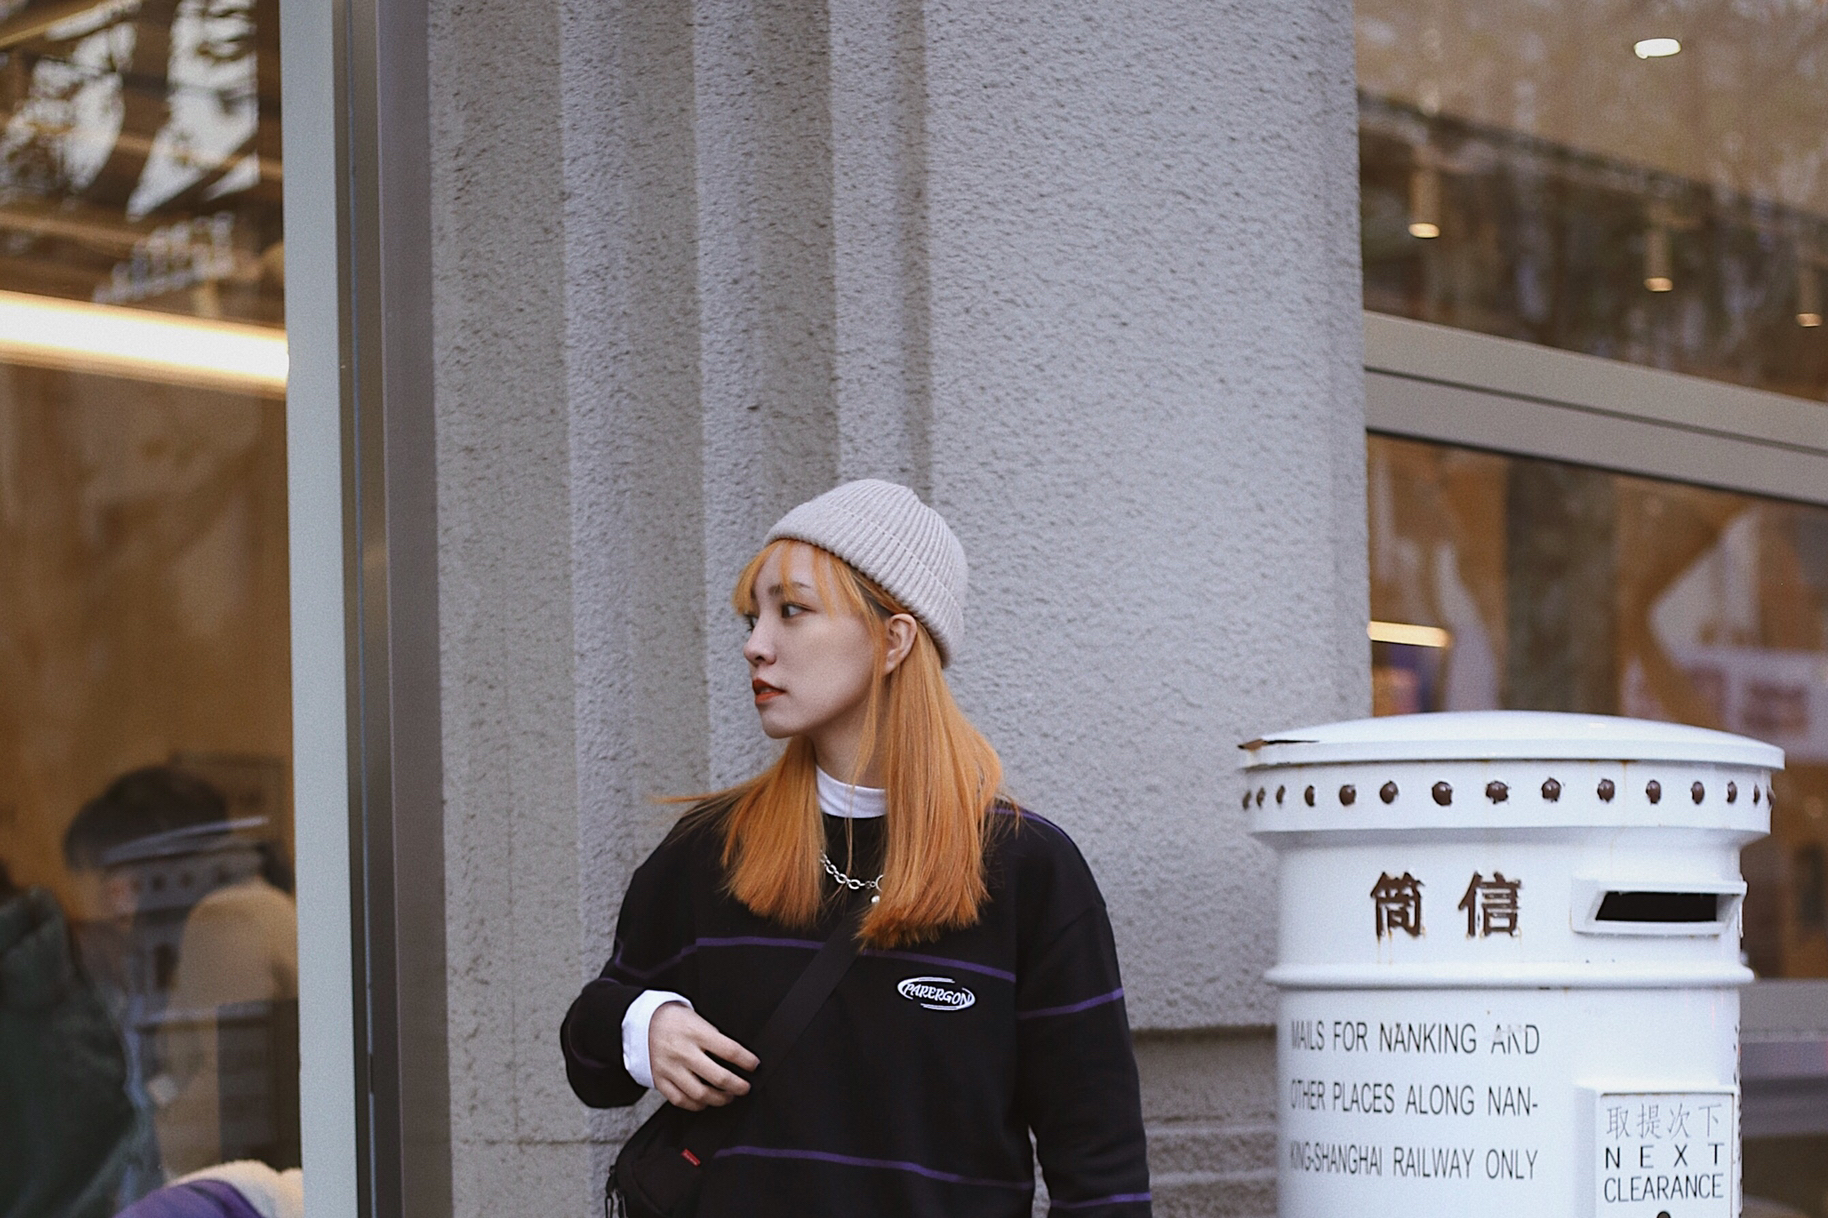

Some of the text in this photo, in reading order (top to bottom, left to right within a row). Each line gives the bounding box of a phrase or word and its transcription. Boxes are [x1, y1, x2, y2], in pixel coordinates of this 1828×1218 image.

[904, 982, 971, 1006] PARERGON
[1291, 1019, 1541, 1056] MAILS FOR NANKING AND
[1291, 1078, 1539, 1117] OTHER PLACES ALONG NAN-
[1290, 1140, 1539, 1181] KING-SHANGHAI RAILWAY ONLY
[1604, 1142, 1726, 1170] NEXT
[1603, 1172, 1724, 1204] CLEARANCE
